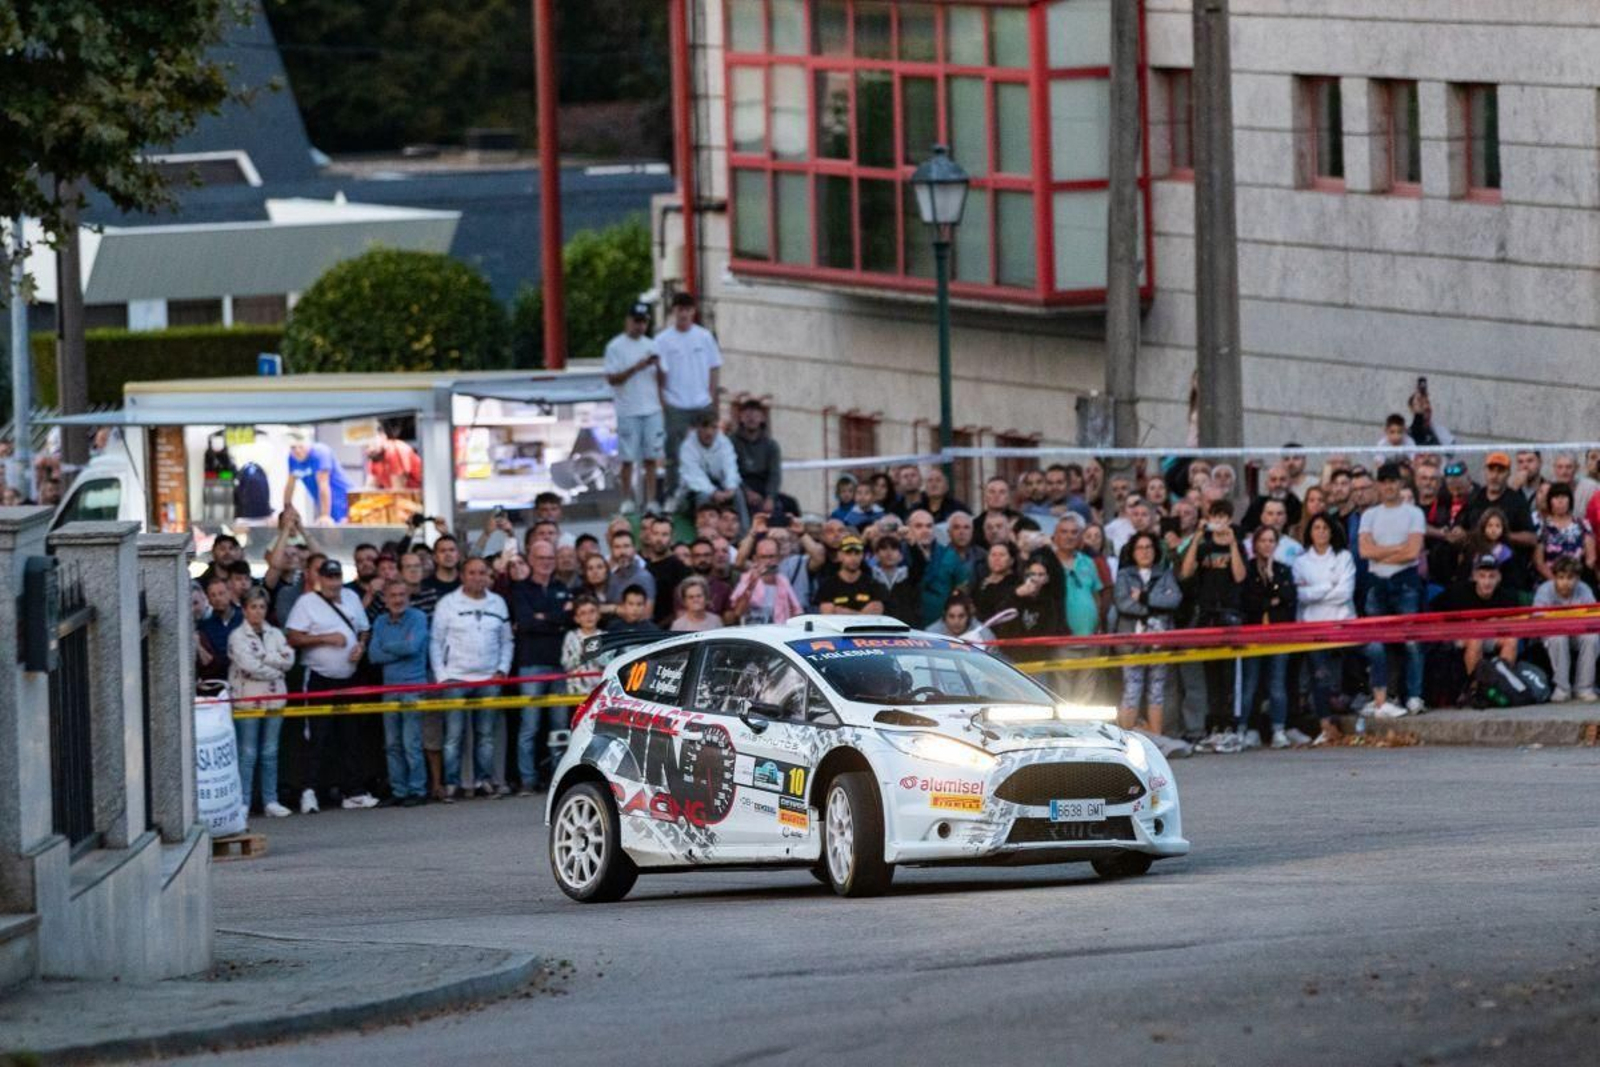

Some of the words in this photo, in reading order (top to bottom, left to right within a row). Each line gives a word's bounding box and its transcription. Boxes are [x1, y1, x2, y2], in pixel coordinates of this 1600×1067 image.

[852, 638, 933, 649] Recalvi
[625, 661, 647, 692] 10
[789, 767, 805, 796] 10
[920, 776, 985, 795] alumisel
[1058, 804, 1082, 817] 6638
